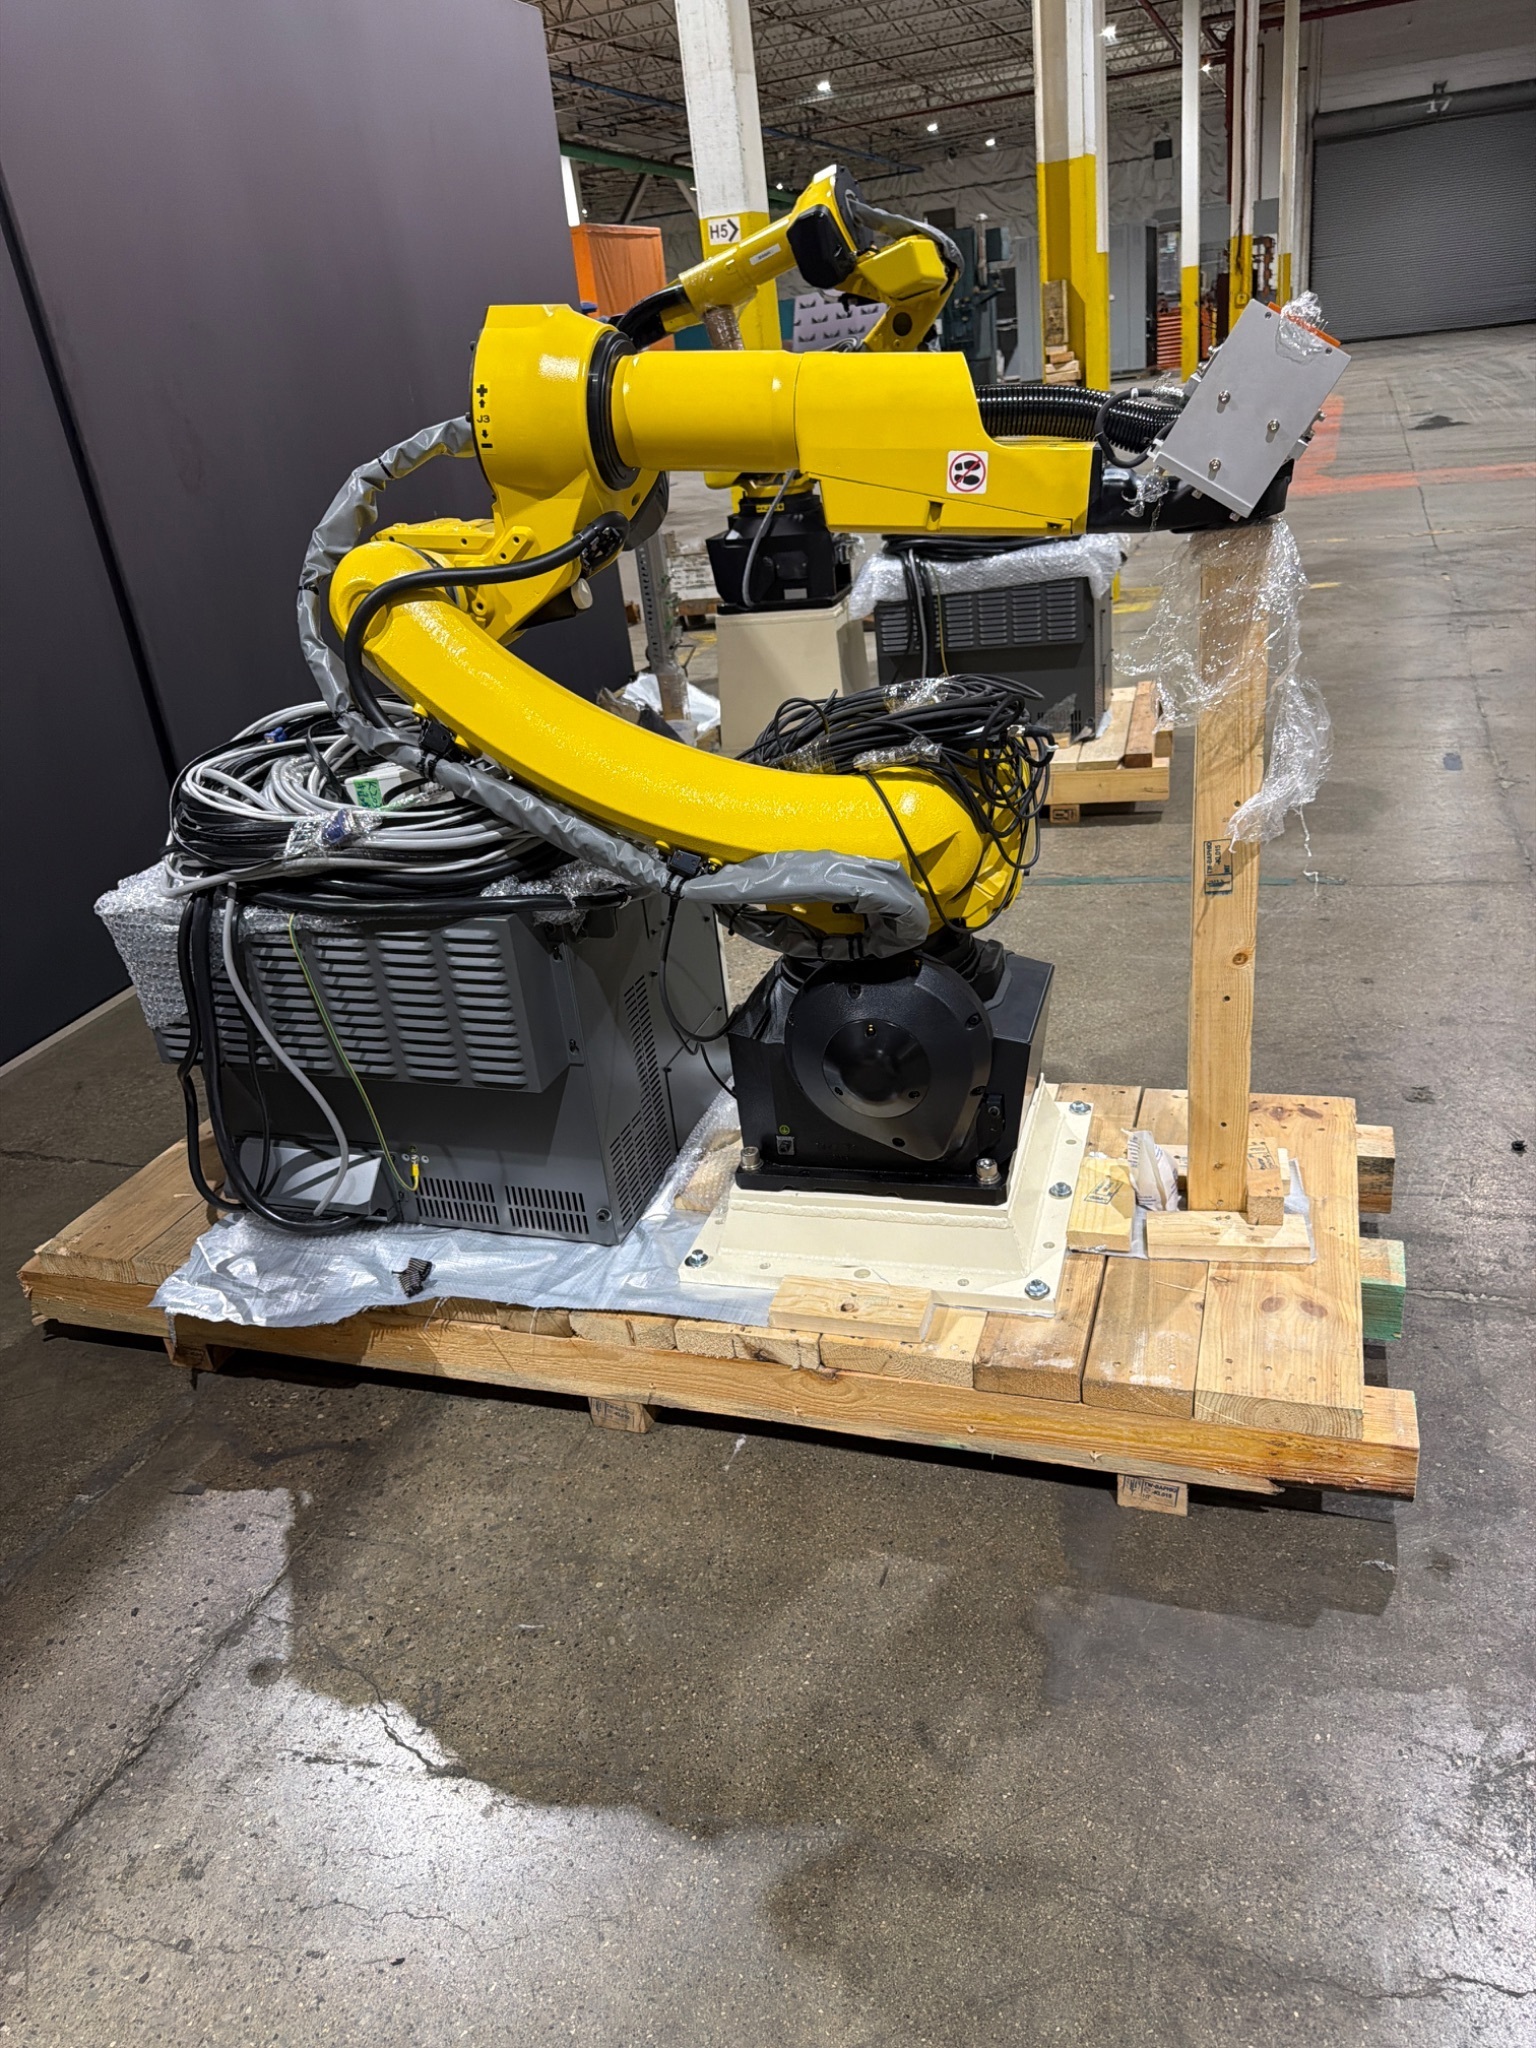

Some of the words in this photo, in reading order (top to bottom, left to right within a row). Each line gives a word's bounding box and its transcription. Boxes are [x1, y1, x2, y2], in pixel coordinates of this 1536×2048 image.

[1427, 96, 1453, 113] 17
[710, 224, 728, 239] H5
[476, 415, 490, 423] J3
